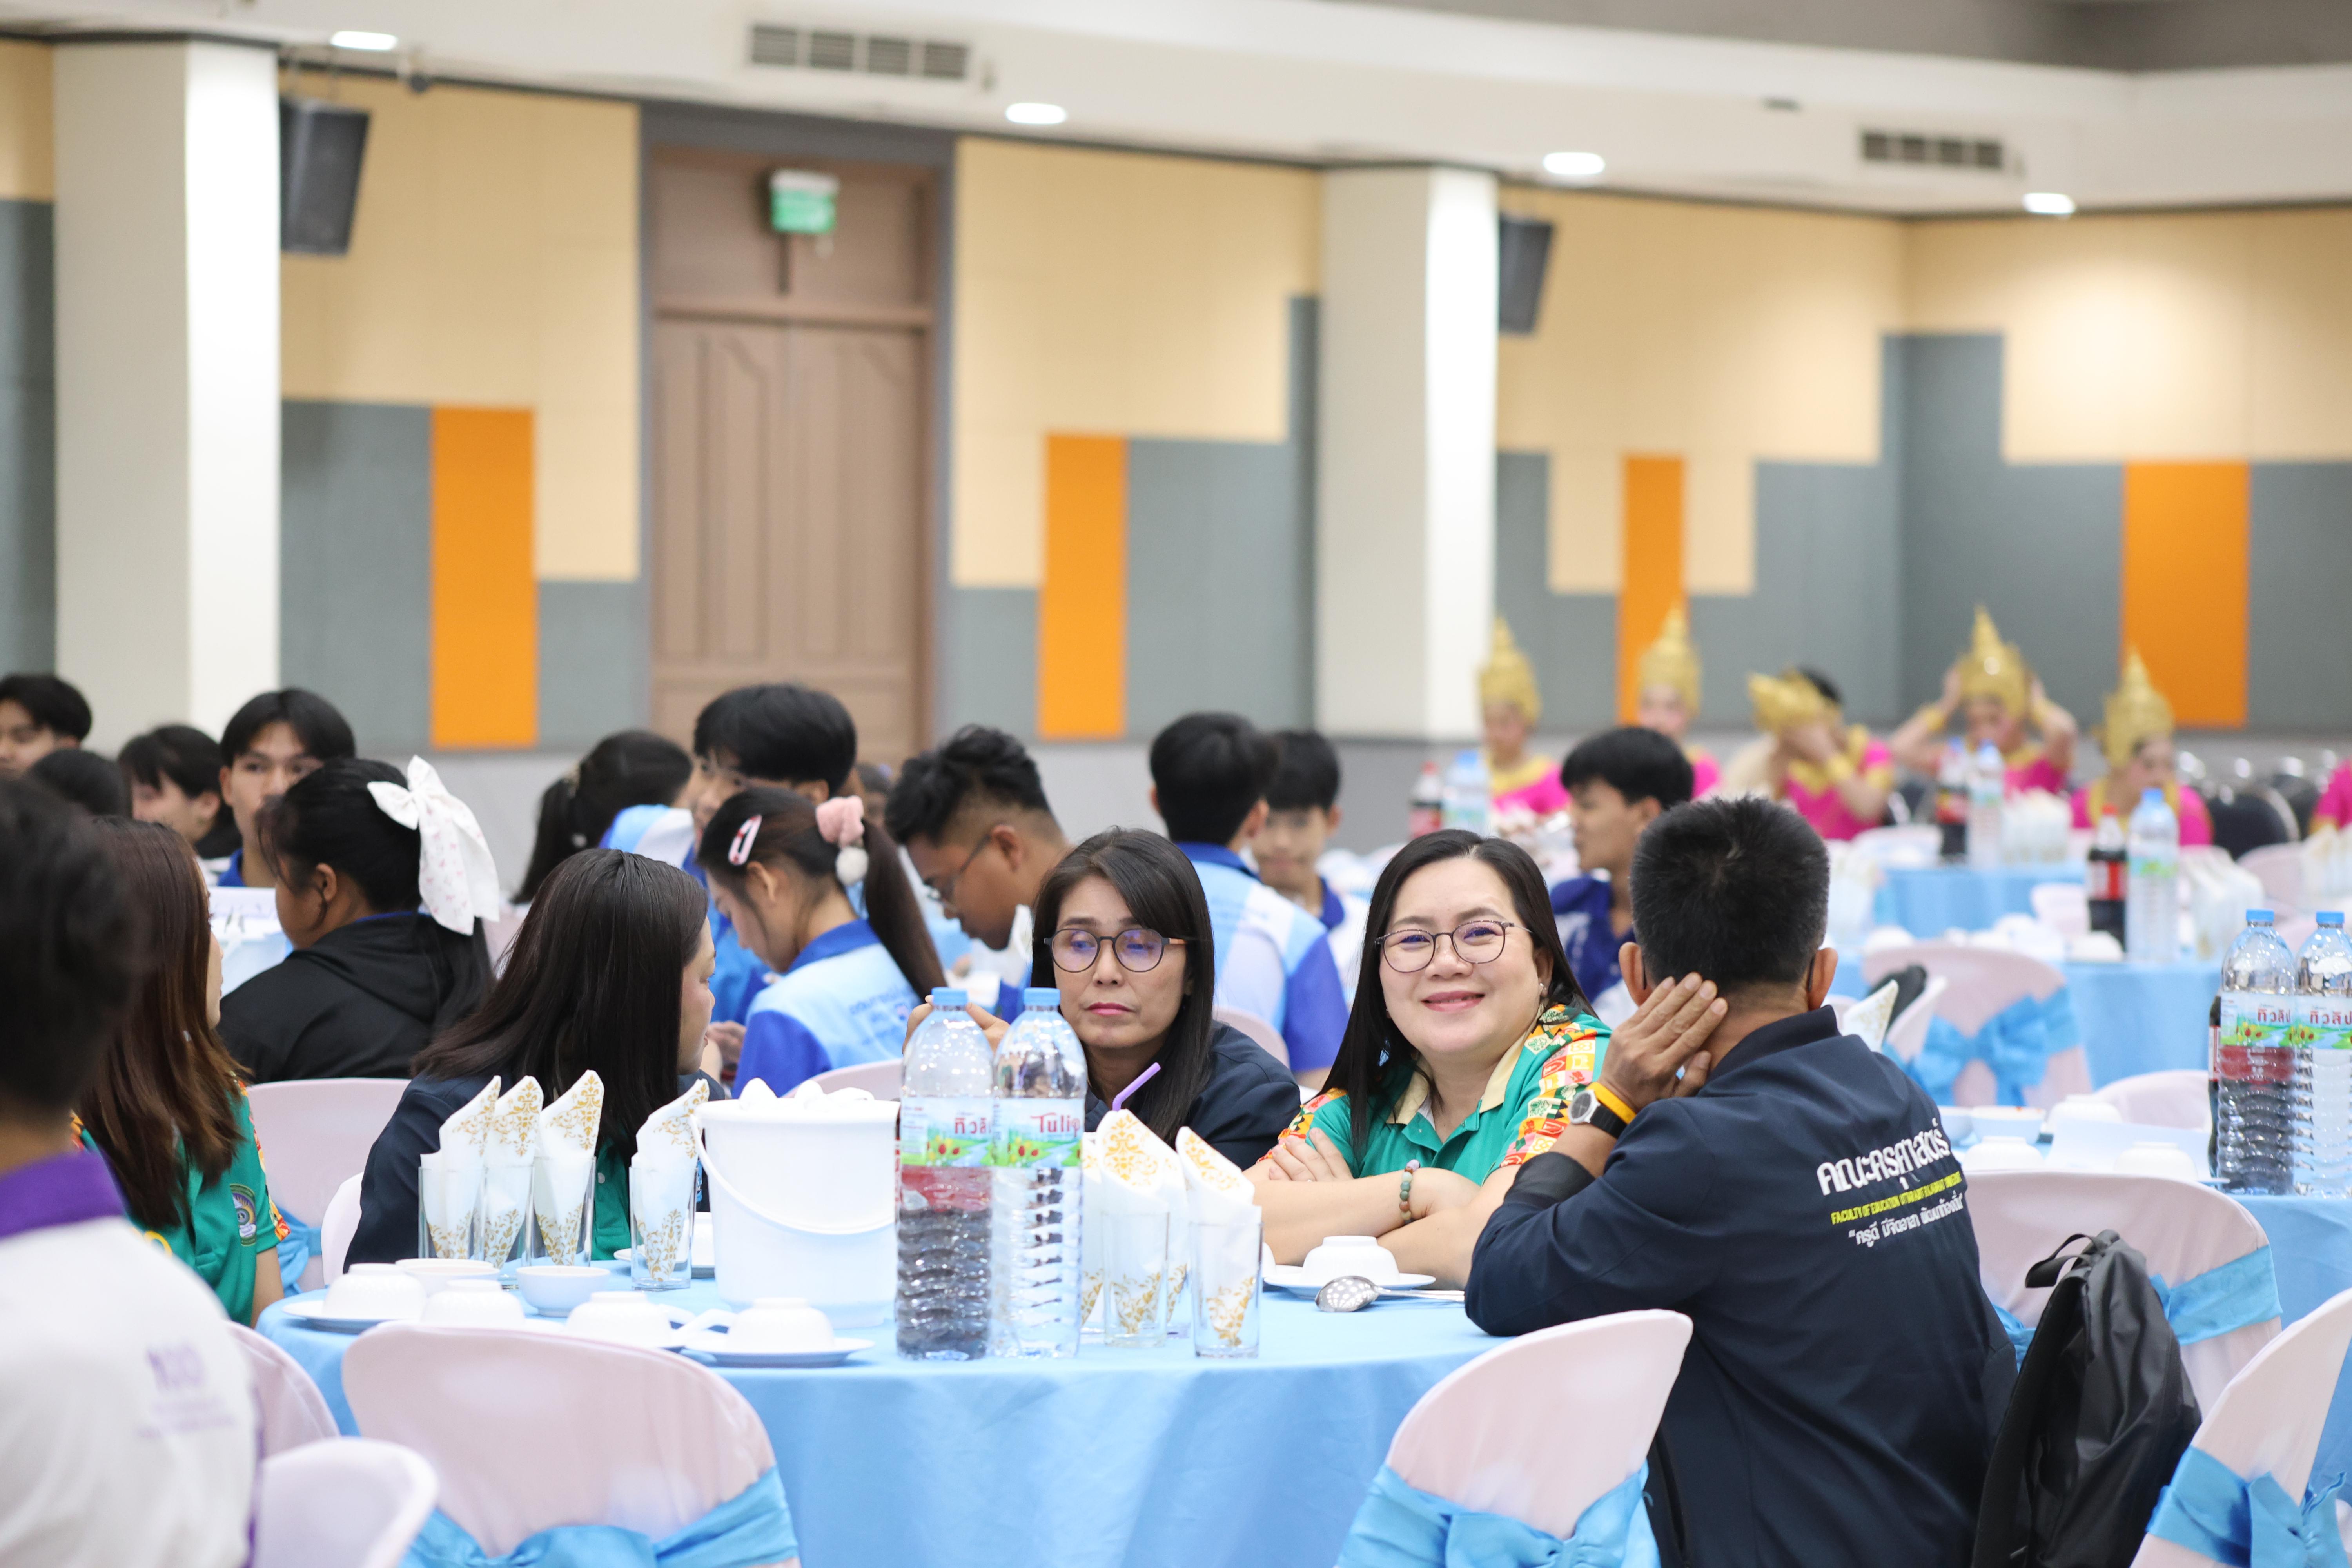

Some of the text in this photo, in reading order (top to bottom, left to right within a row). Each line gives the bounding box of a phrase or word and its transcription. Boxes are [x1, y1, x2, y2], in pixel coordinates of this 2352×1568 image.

[1030, 1112, 1080, 1138] Tulip
[1817, 1117, 1951, 1196] คณะครุศาสตร์
